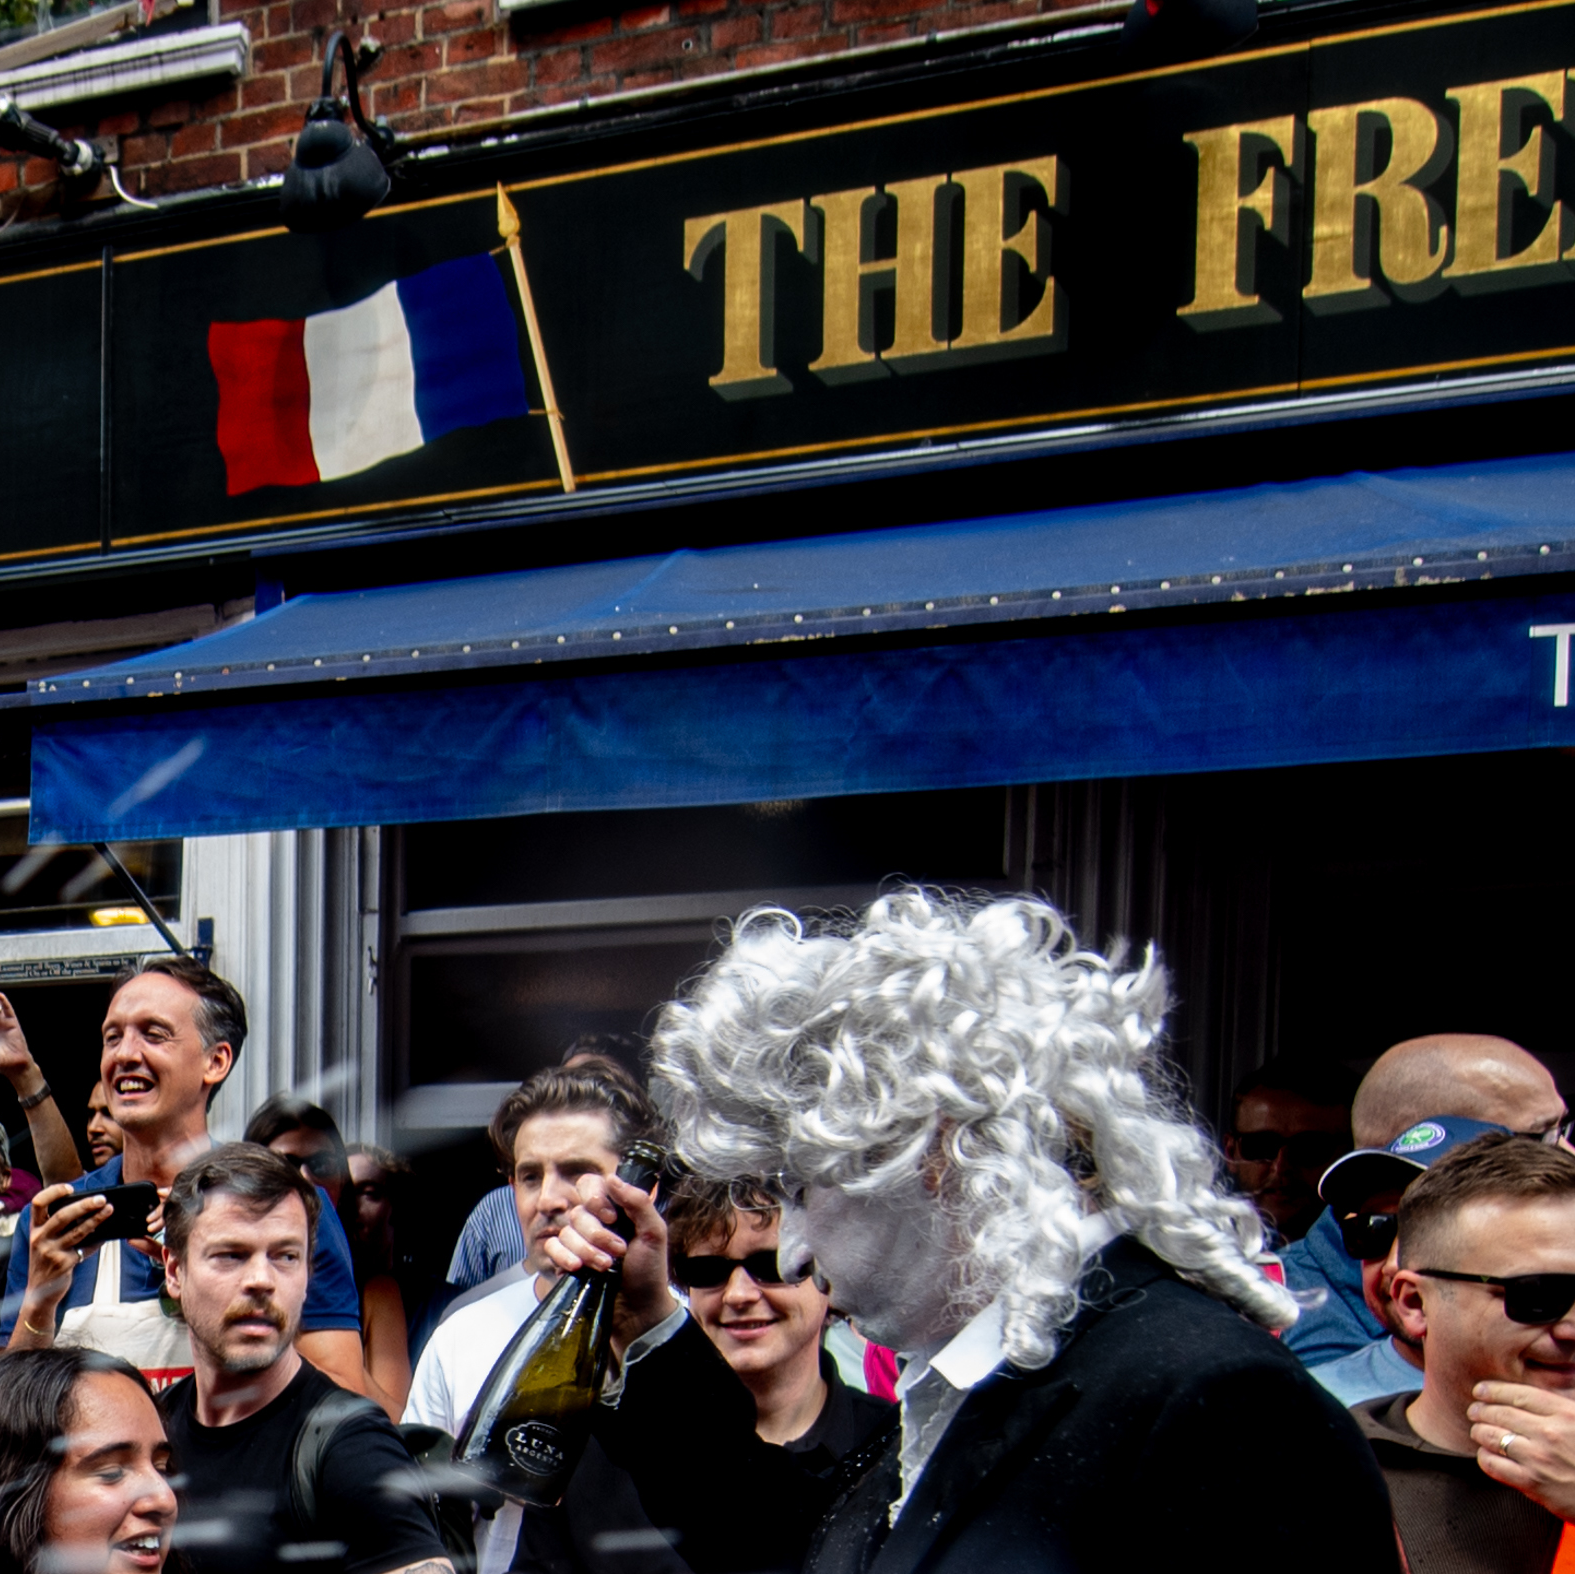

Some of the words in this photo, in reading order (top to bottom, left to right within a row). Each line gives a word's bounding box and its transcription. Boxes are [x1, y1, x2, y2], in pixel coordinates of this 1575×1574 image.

[683, 154, 1059, 390] THE
[1176, 66, 1575, 318] FRE
[515, 1431, 564, 1461] LUNA
